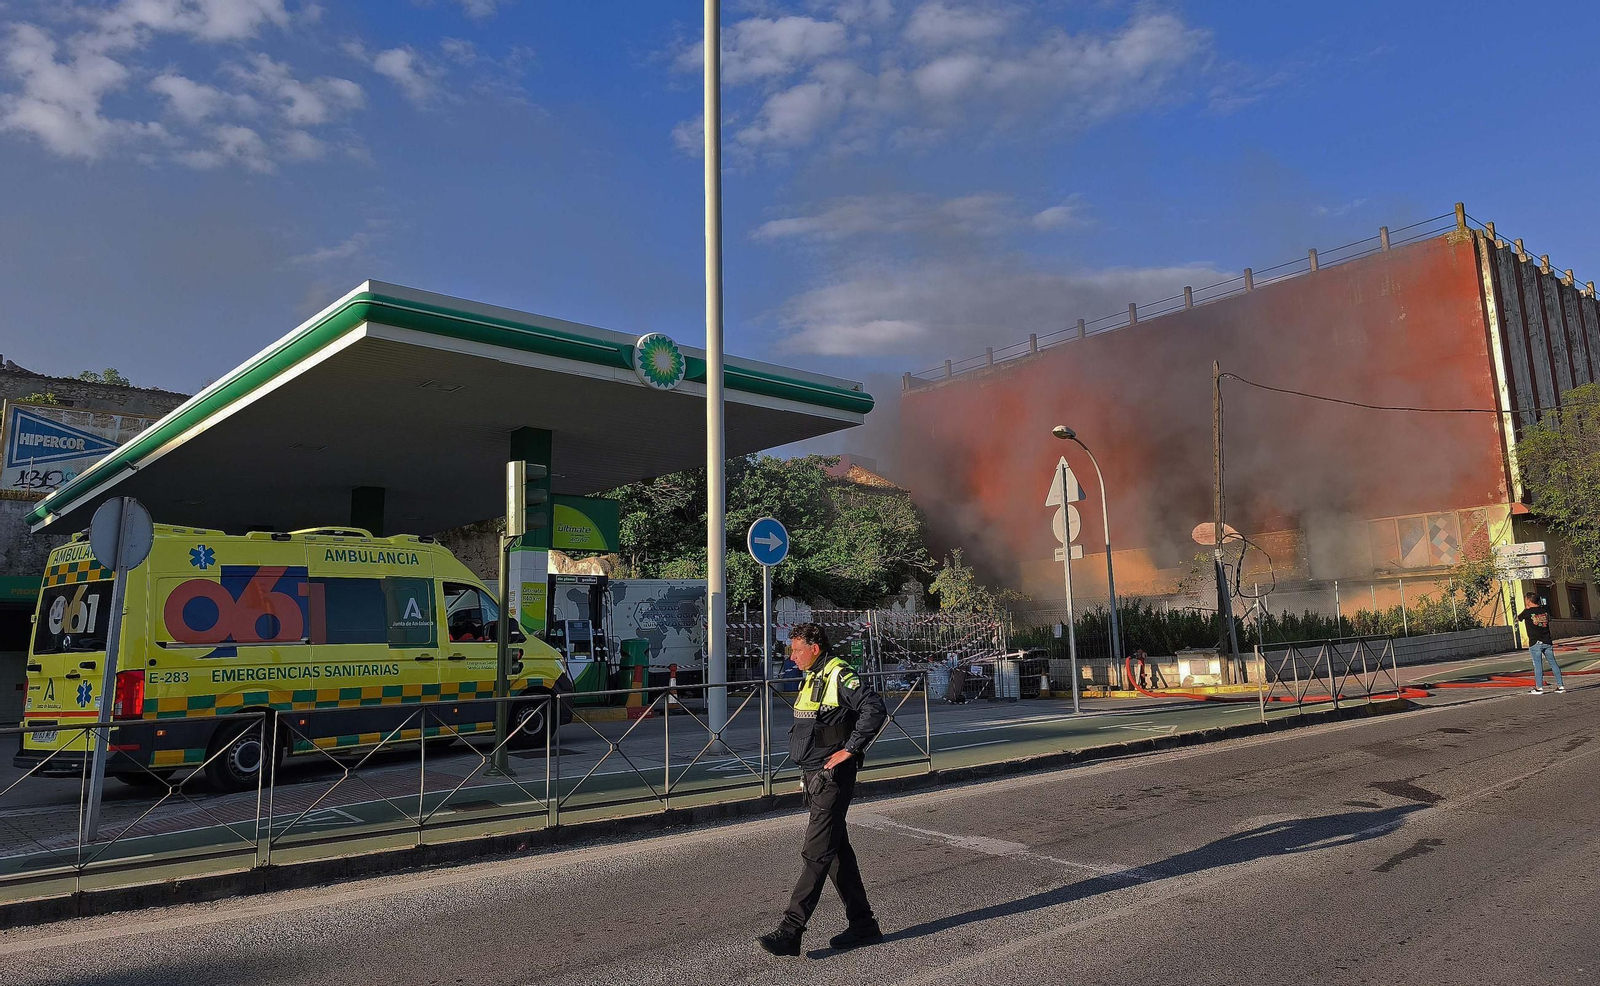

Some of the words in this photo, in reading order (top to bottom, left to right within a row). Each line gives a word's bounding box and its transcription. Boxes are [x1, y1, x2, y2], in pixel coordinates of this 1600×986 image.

[19, 432, 85, 451] HIPERCOR
[325, 549, 419, 565] AMBULANCIA
[49, 584, 99, 634] 061
[164, 566, 327, 643] 061
[149, 672, 189, 684] E-283
[211, 666, 320, 682] EMERGENCIAS
[324, 664, 399, 677] SANITARIAS
